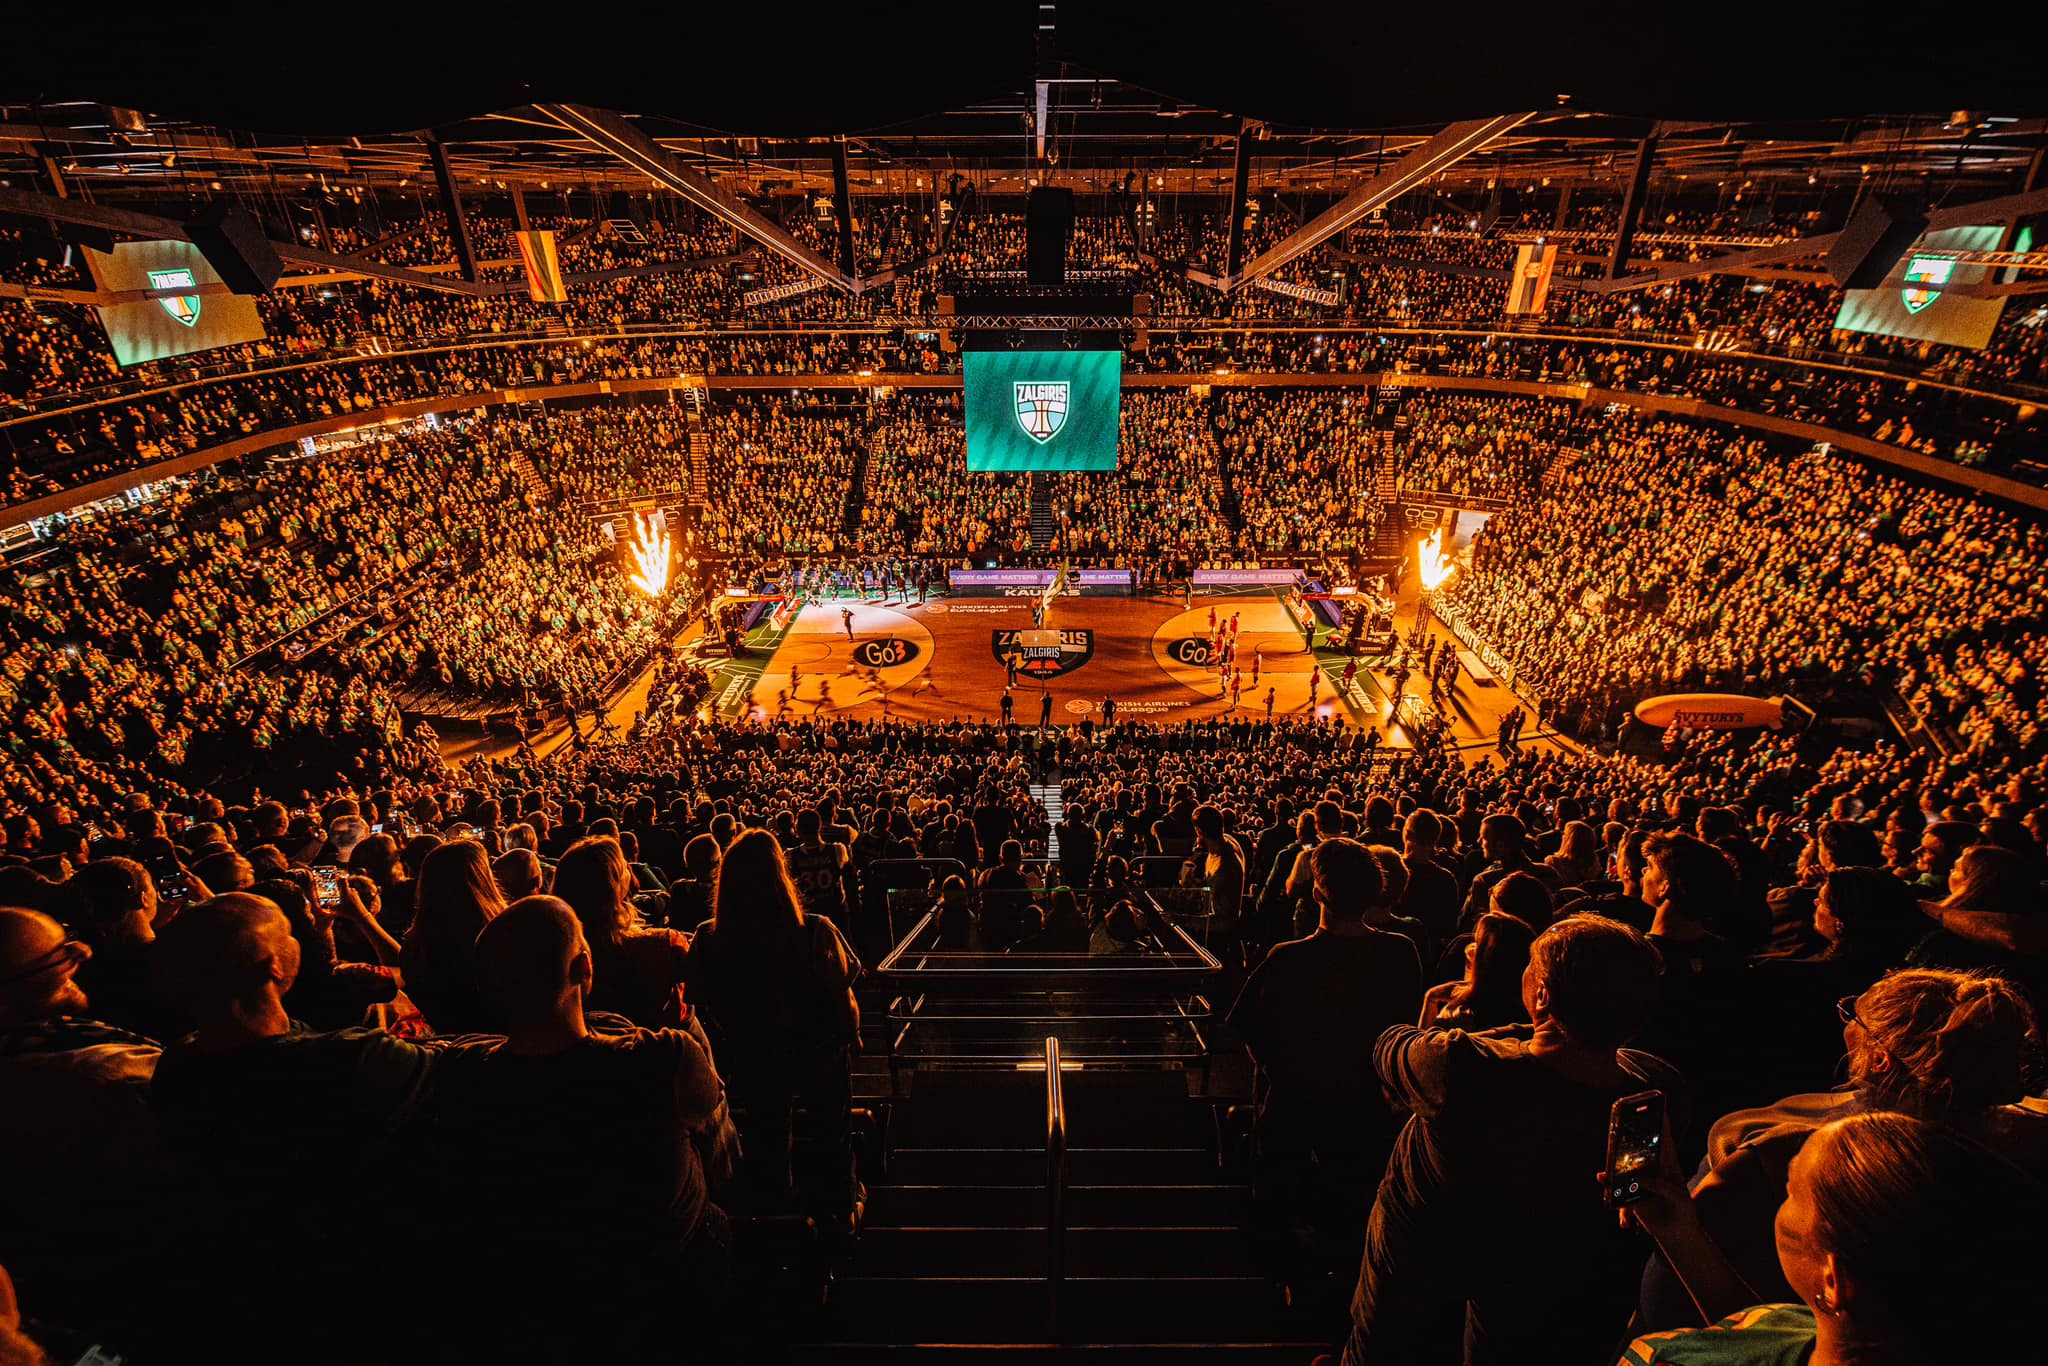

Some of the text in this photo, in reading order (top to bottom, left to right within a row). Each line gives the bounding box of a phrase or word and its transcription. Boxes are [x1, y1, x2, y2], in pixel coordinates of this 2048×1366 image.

[1017, 385, 1067, 402] ZALGIRIS
[998, 631, 1088, 646] ZARIS
[866, 640, 907, 665] Go3
[1023, 647, 1061, 659] ZALGIRIS
[1453, 618, 1480, 655] WHITE
[1480, 645, 1510, 680] BOYS
